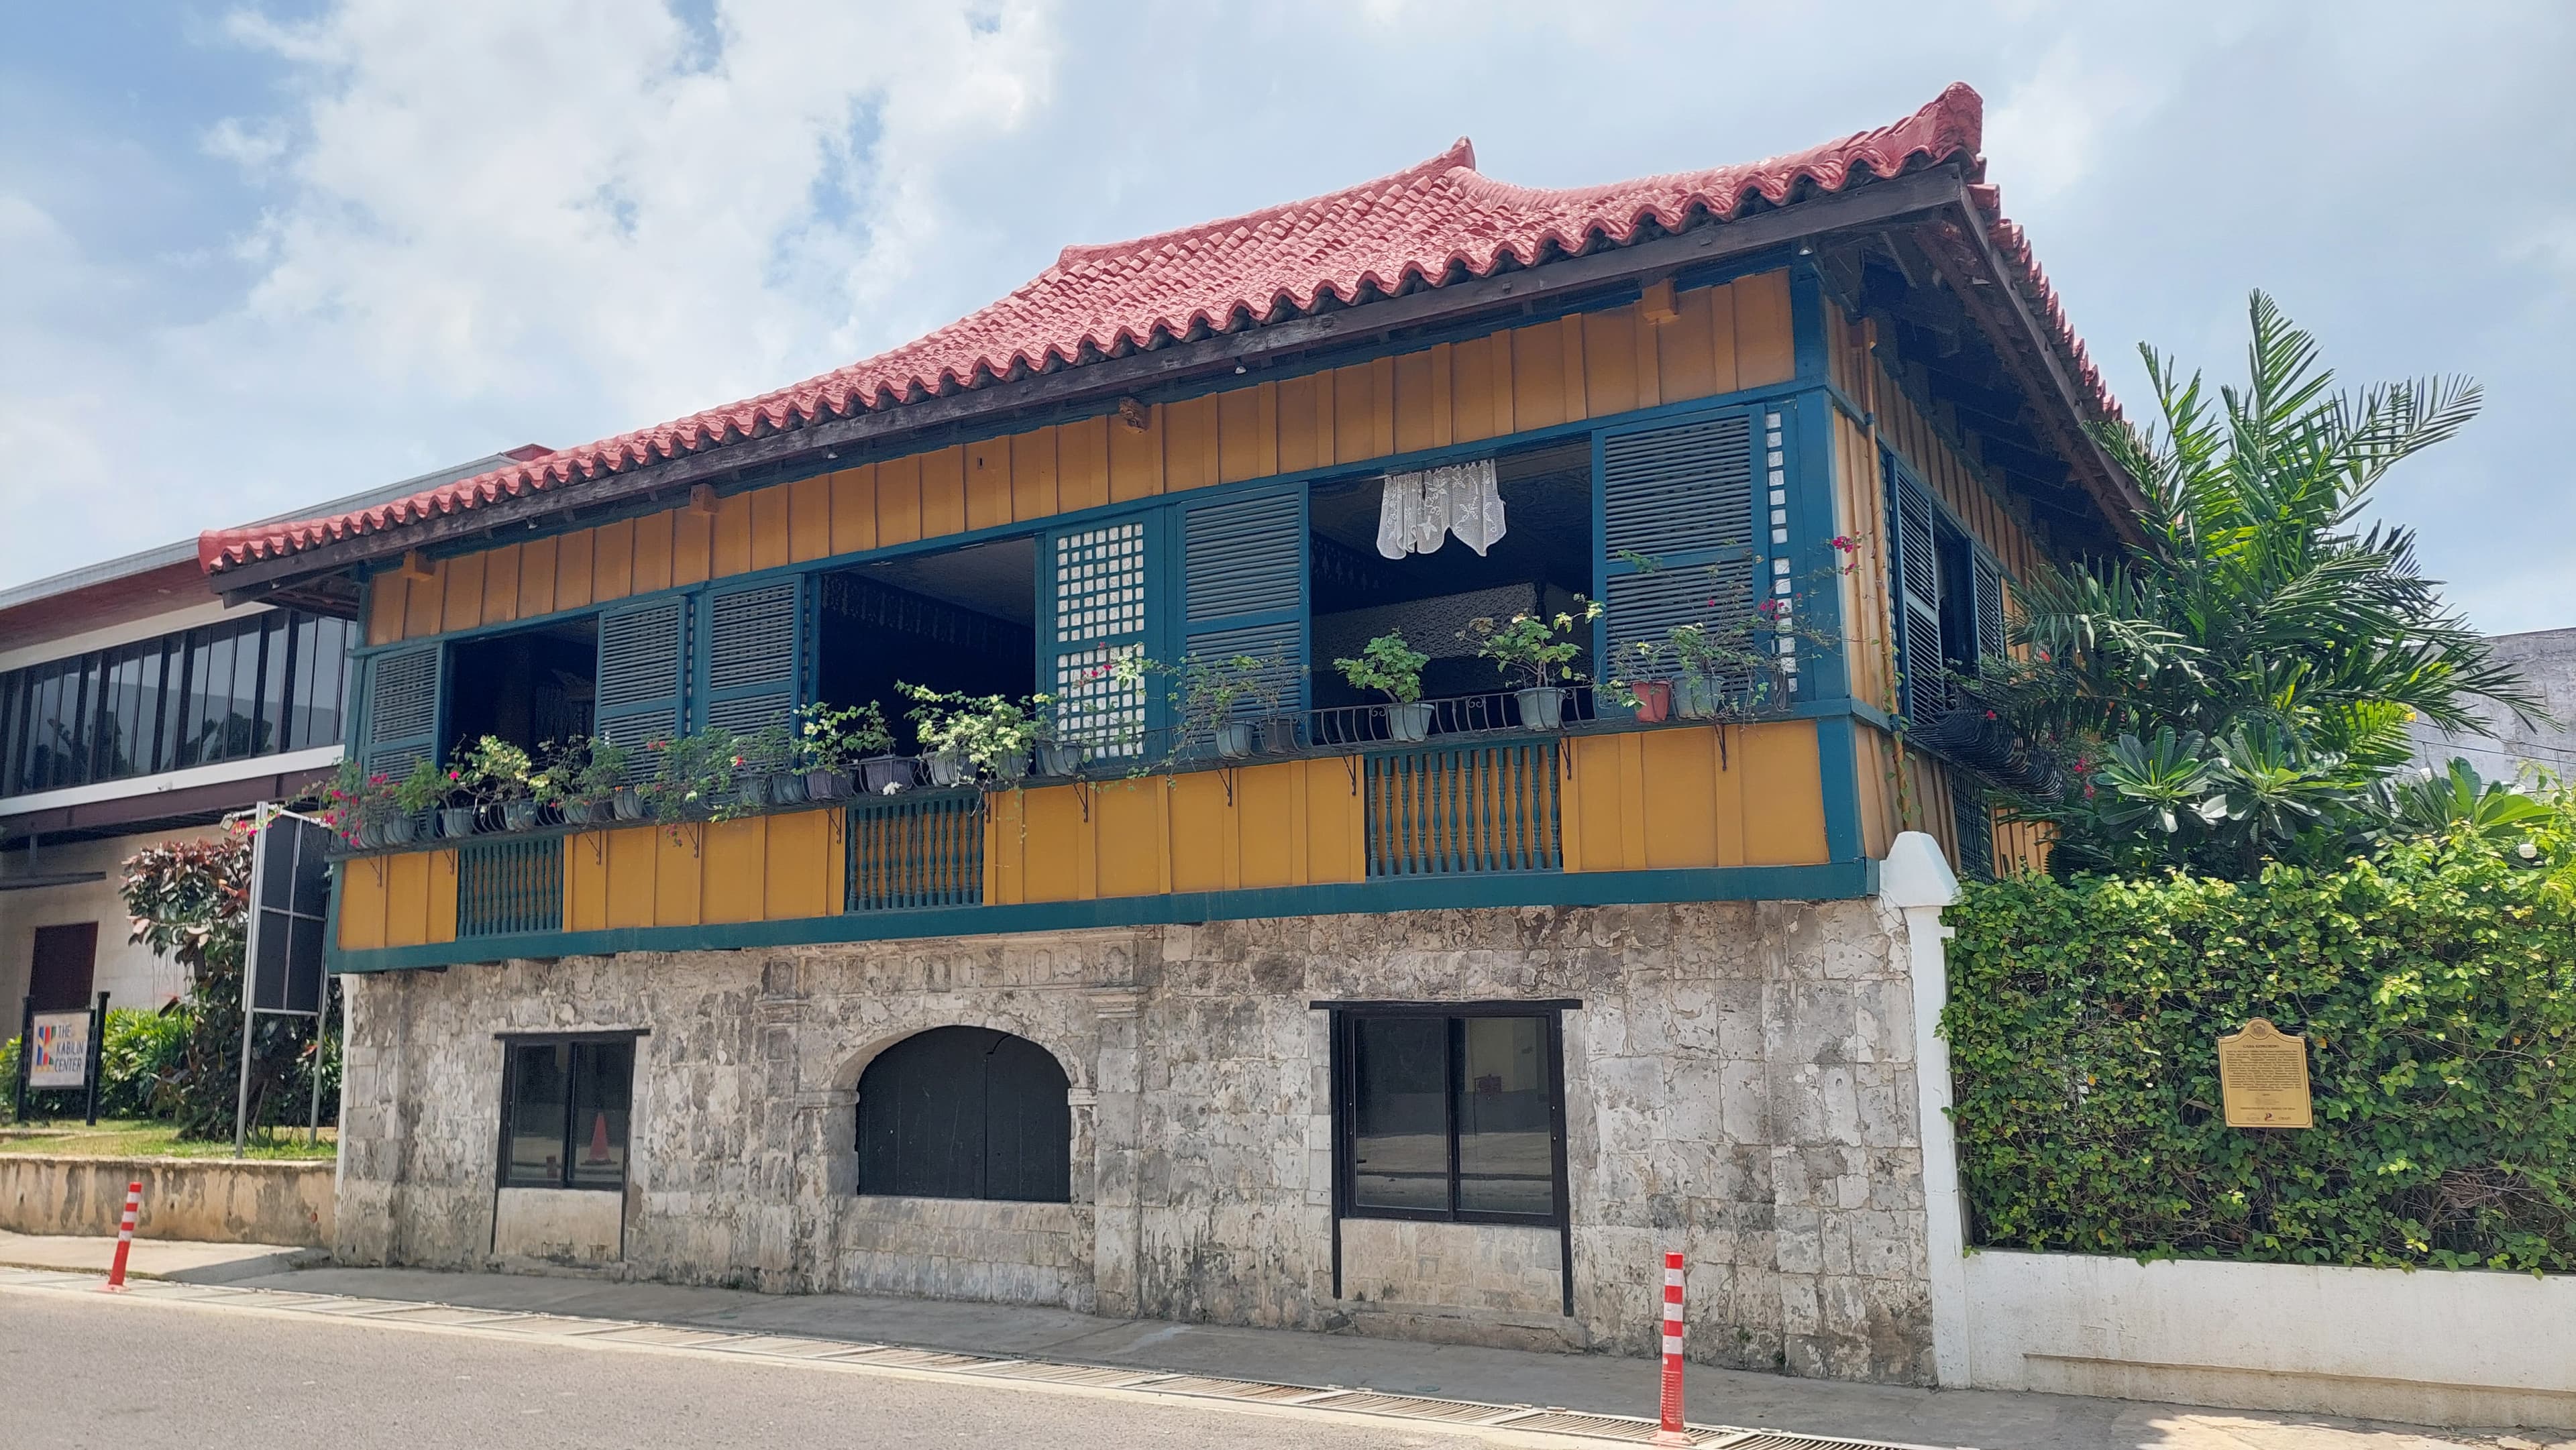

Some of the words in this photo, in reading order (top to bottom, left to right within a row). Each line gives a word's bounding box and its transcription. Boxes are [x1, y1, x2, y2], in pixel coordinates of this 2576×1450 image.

[58, 1024, 72, 1038] THE
[56, 1040, 84, 1056] KABILIN
[54, 1057, 82, 1073] CENTER
